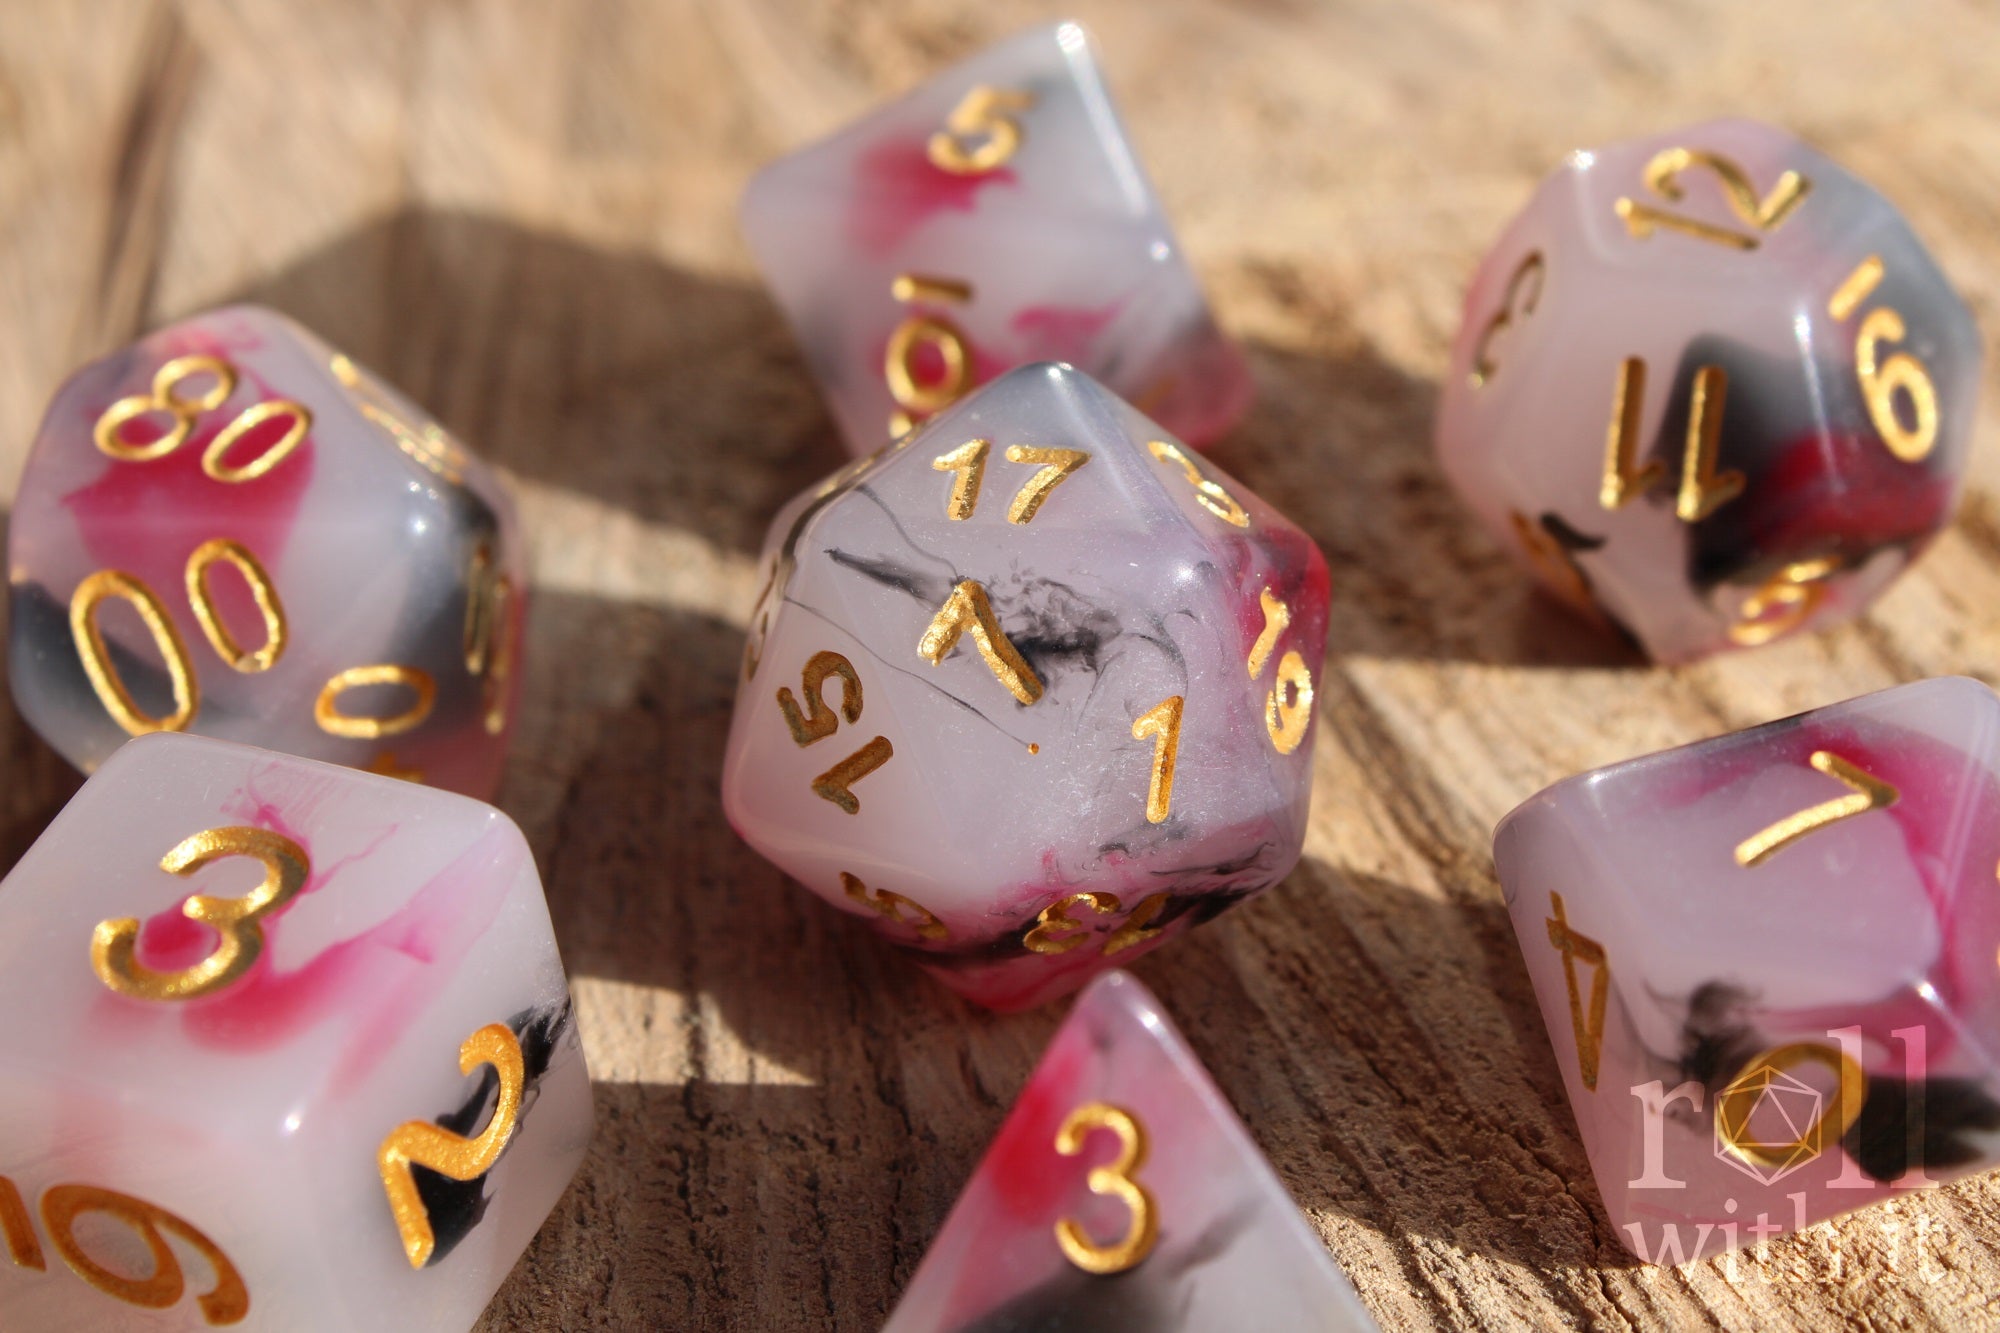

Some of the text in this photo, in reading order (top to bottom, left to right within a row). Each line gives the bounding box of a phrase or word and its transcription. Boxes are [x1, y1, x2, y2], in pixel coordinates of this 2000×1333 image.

[928, 84, 1038, 174] 5
[1615, 147, 1813, 250] 12
[95, 355, 312, 483] 80
[933, 438, 1091, 524] 17
[1601, 357, 1747, 521] 11
[70, 538, 287, 736] 00
[1132, 695, 1184, 823] 1
[1733, 750, 1900, 868] 7
[90, 825, 310, 1001] 3
[1545, 890, 1611, 1093] 4
[377, 1023, 525, 1270] 2
[1054, 1103, 1161, 1275] 3
